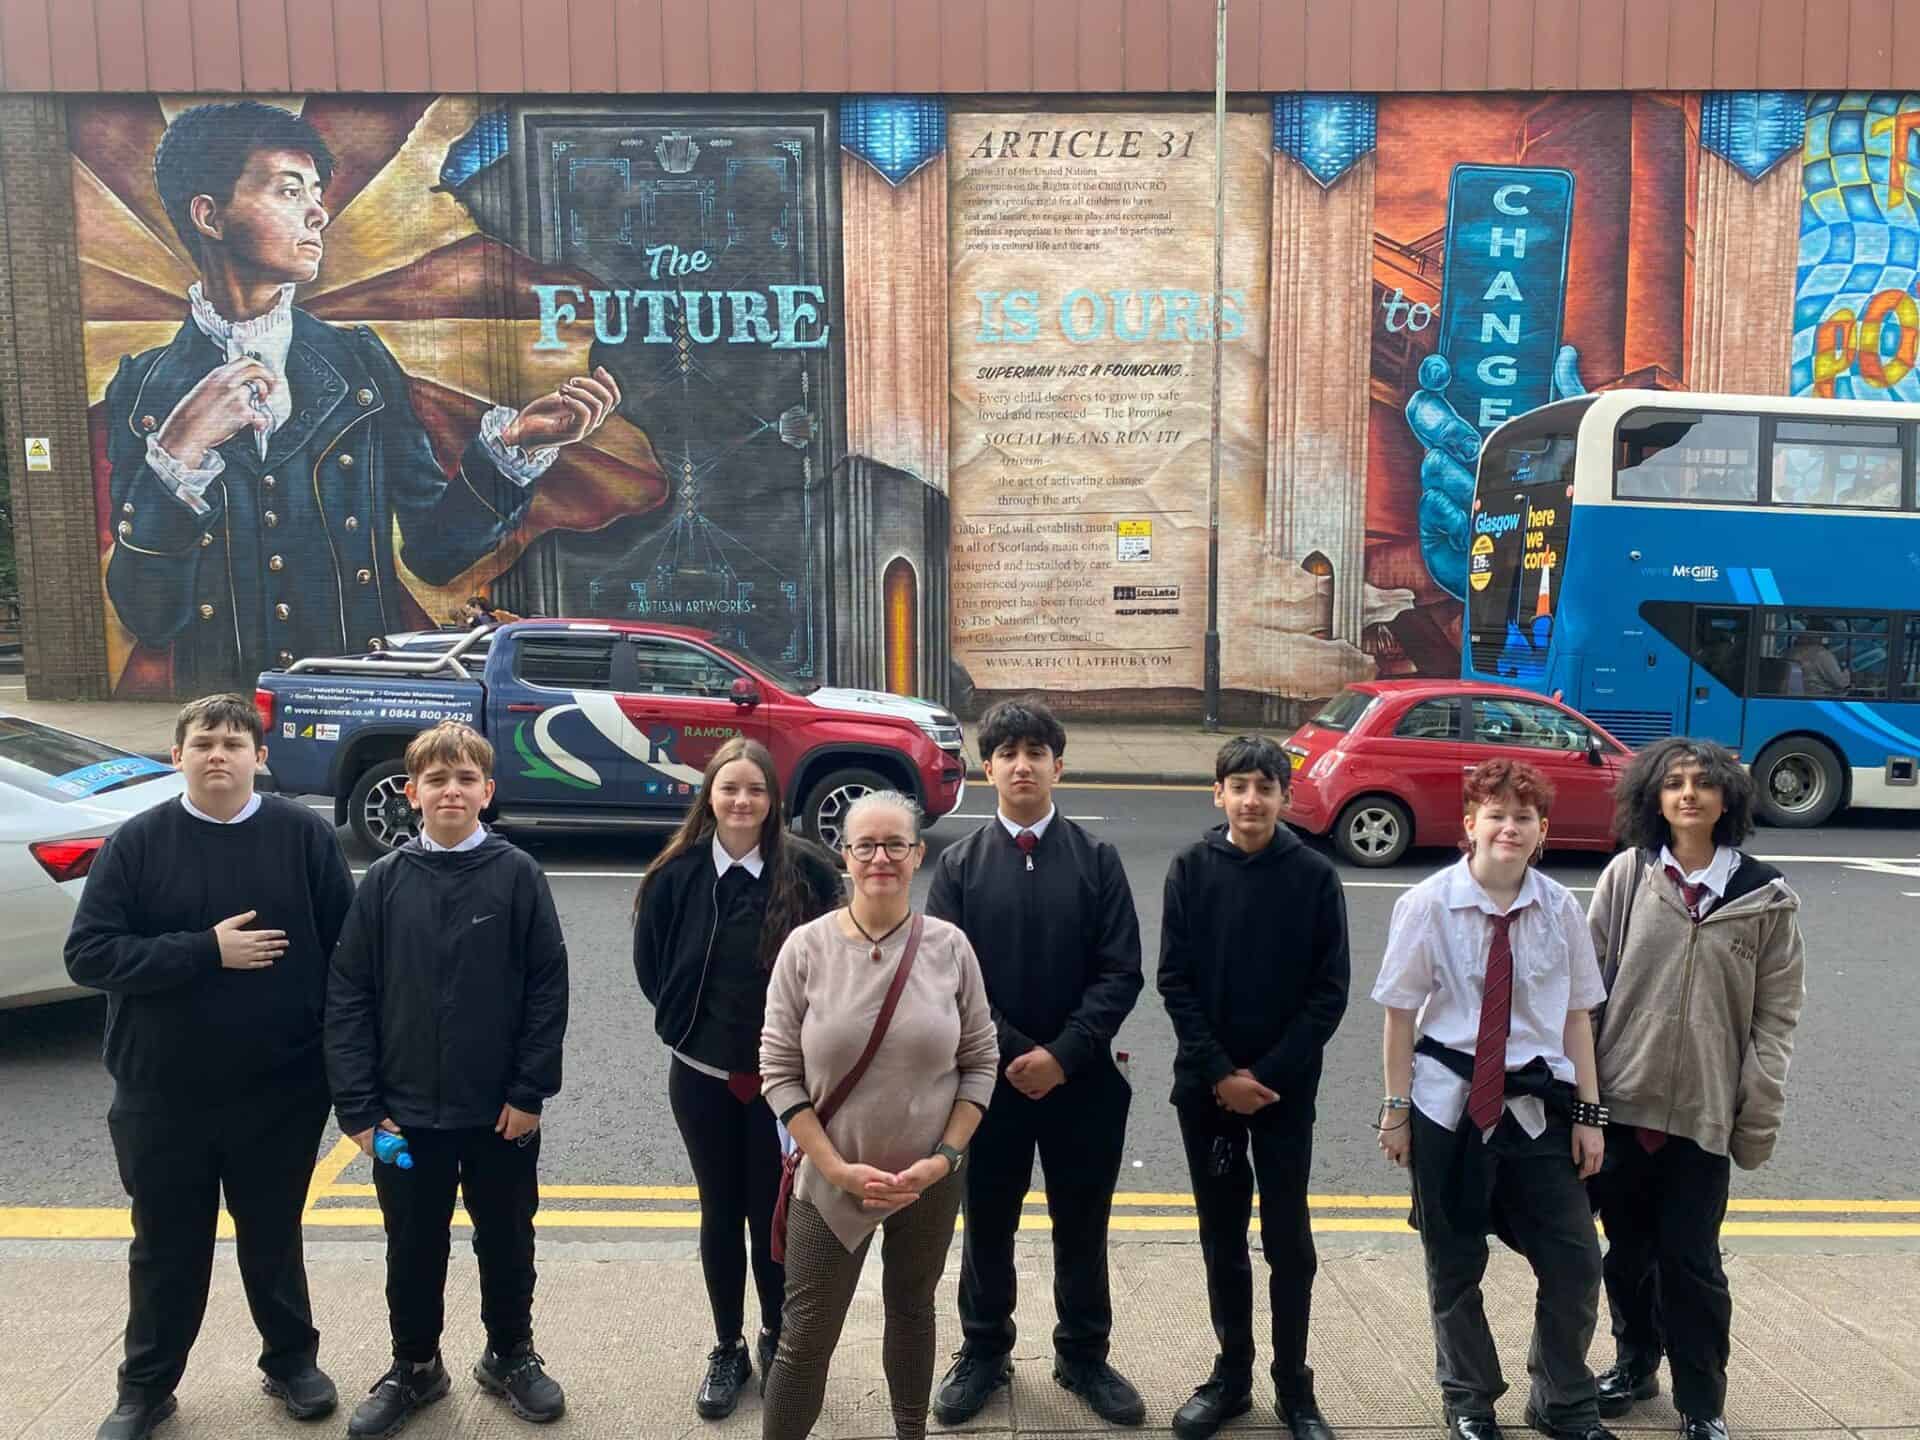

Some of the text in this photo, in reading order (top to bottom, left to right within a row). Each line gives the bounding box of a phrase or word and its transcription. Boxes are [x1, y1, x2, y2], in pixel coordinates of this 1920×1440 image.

[968, 129, 1196, 159] ARTICLE 31
[645, 244, 713, 280] The
[1381, 288, 1440, 333] to
[1477, 184, 1531, 428] CHANGE
[530, 284, 830, 350] FUTURE
[975, 287, 1247, 344] IS OURS
[976, 365, 1056, 379] SUPERMAN
[1057, 364, 1088, 377] WAS
[1090, 364, 1102, 376] A
[978, 392, 1010, 405] Every
[1014, 391, 1041, 403] child
[1045, 391, 1093, 402] deserves
[1095, 391, 1105, 401] to
[1109, 392, 1138, 403] grow
[1141, 392, 1154, 402] up
[978, 408, 1008, 420] loved
[1011, 408, 1032, 419] and
[1105, 408, 1123, 418] The
[1129, 407, 1173, 418] Promise
[984, 433, 1042, 445] SOCIAL
[1051, 432, 1109, 445] WEANS
[1116, 431, 1152, 444] RUN
[998, 475, 1144, 488] the act of activating change
[998, 495, 1039, 506] through
[1042, 494, 1059, 504] the
[1528, 505, 1555, 528] here
[1011, 523, 1033, 533] will
[1037, 522, 1082, 533] establish
[1475, 512, 1520, 538] Glasgow
[966, 542, 980, 552] all
[983, 542, 995, 552] of
[1526, 531, 1544, 549] we
[953, 560, 1000, 573] designed
[1003, 560, 1023, 570] and
[1026, 559, 1071, 570] installed
[1073, 560, 1087, 572] by
[1672, 565, 1719, 578] McGill's
[956, 599, 977, 609] This
[980, 599, 1017, 610] project
[971, 615, 991, 625] The
[994, 615, 1039, 625] National
[1042, 614, 1080, 627] Lottery
[1050, 631, 1091, 642] Council
[986, 656, 1172, 668] WWW.ARTICULATEHUB.COM
[389, 708, 416, 719] 0844
[420, 710, 441, 720] 800
[684, 726, 744, 738] RAMORA
